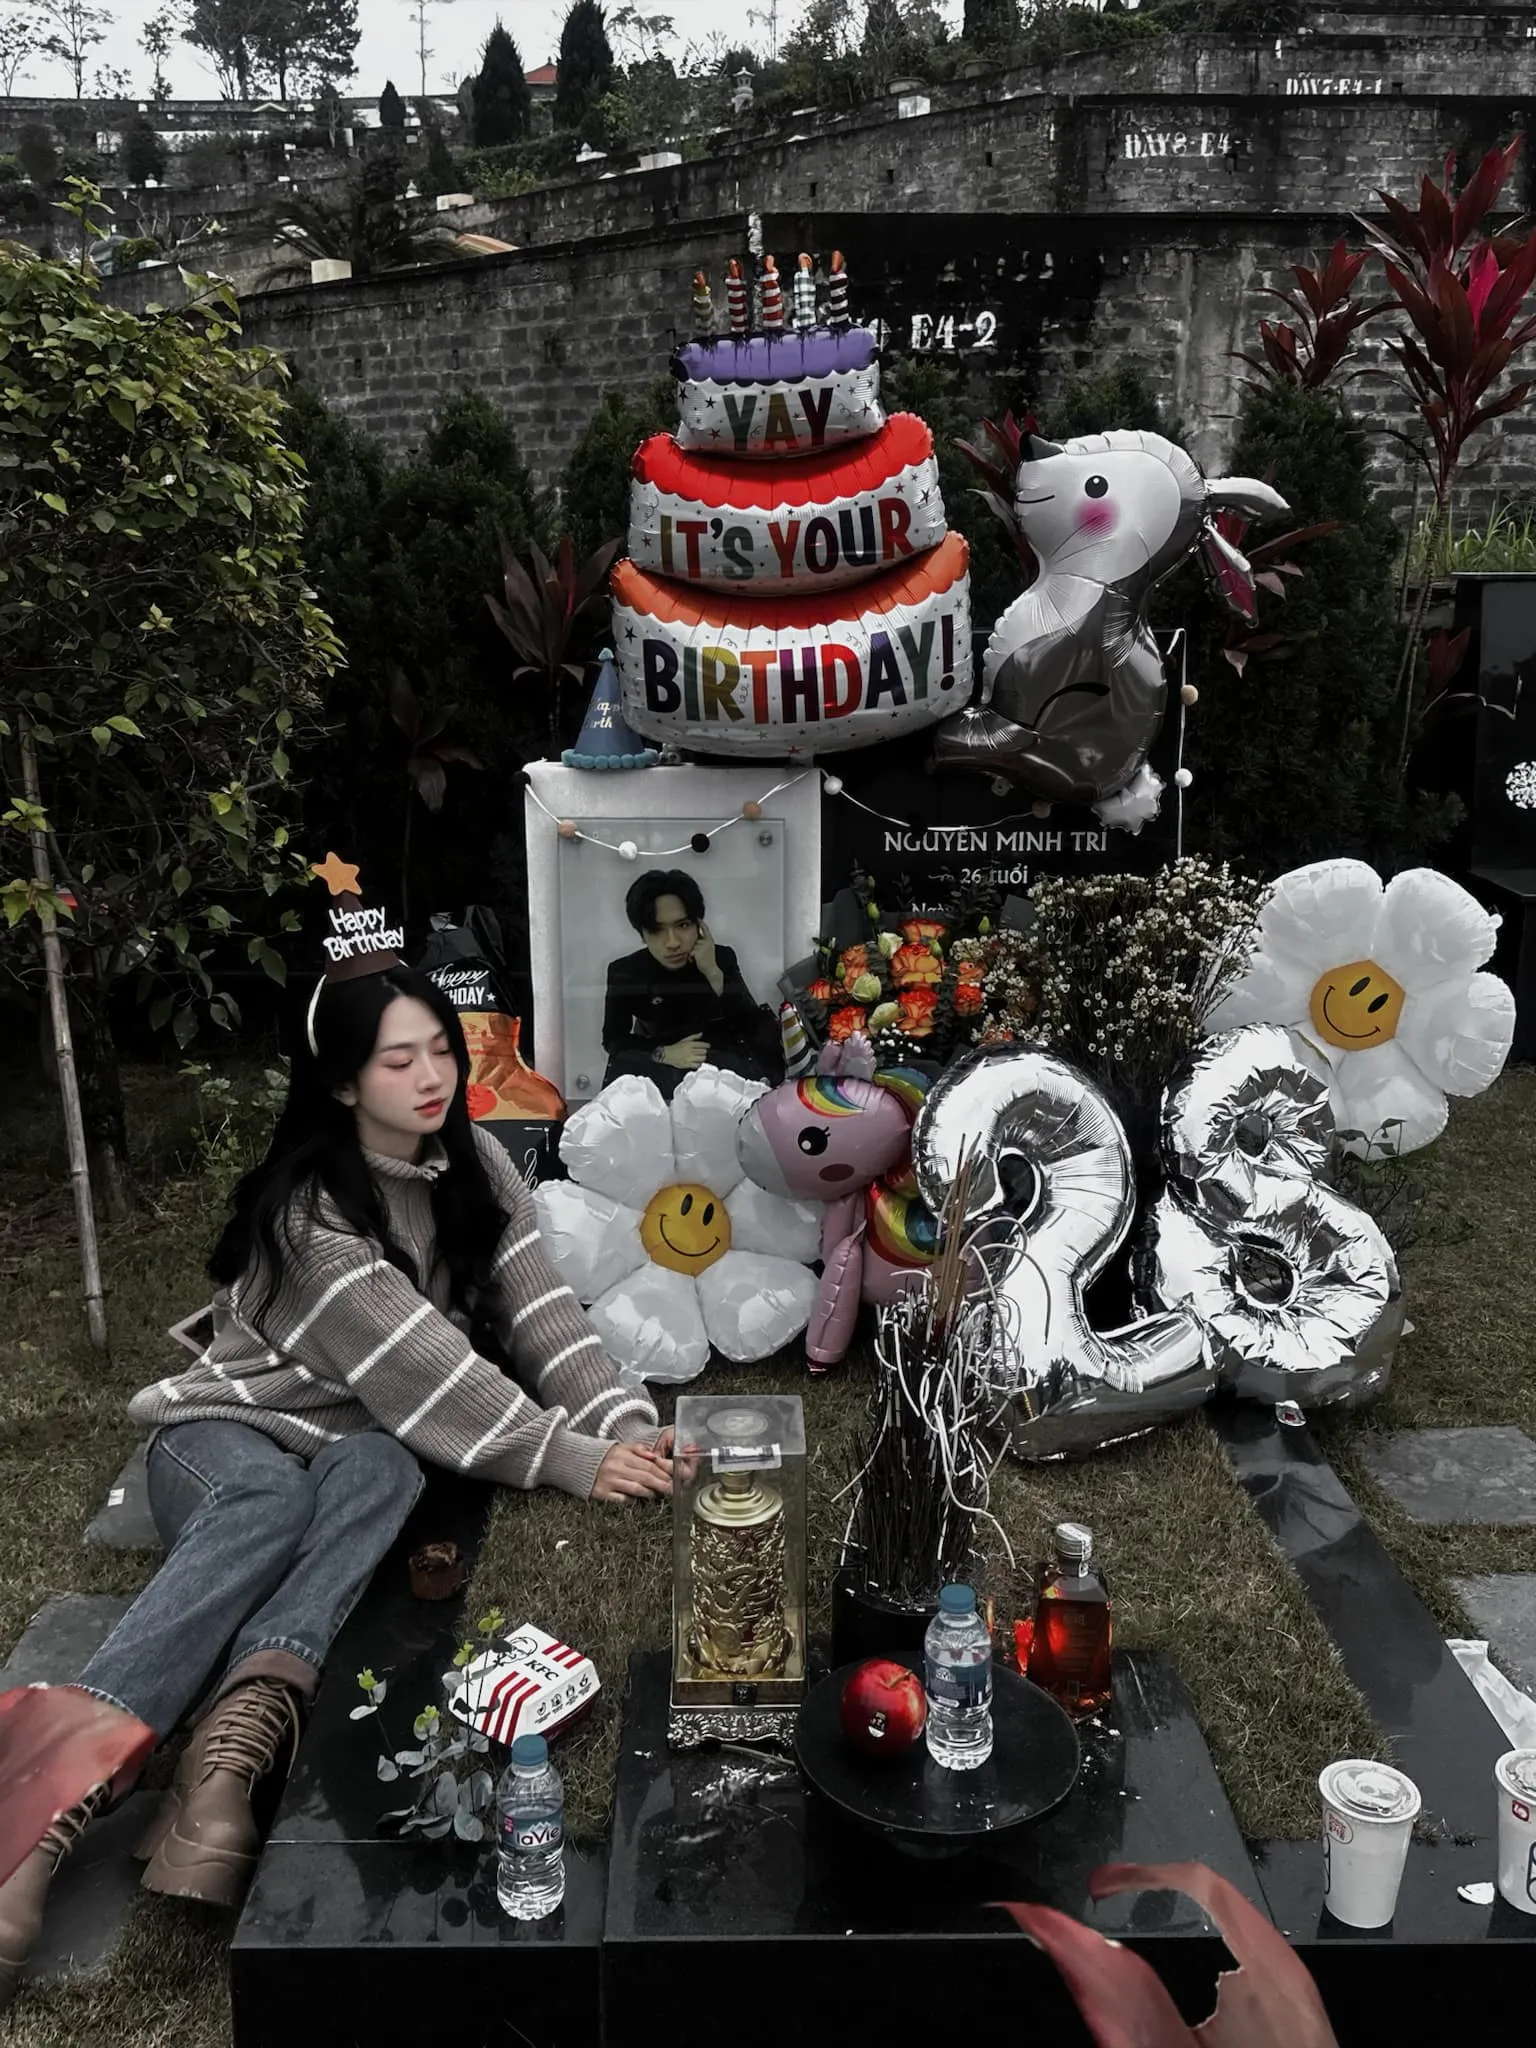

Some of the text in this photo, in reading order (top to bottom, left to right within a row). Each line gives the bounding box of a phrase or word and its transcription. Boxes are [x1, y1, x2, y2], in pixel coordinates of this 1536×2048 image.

[722, 388, 833, 452] YAY
[660, 498, 912, 581] IT'S YOUR
[642, 614, 955, 725] BIRTHDAY!
[996, 831, 1062, 851] MINH
[960, 868, 981, 884] 26
[328, 906, 385, 934] Happy
[322, 926, 404, 962] Birthday
[425, 962, 490, 990] Happy
[524, 1659, 559, 1681] KFC
